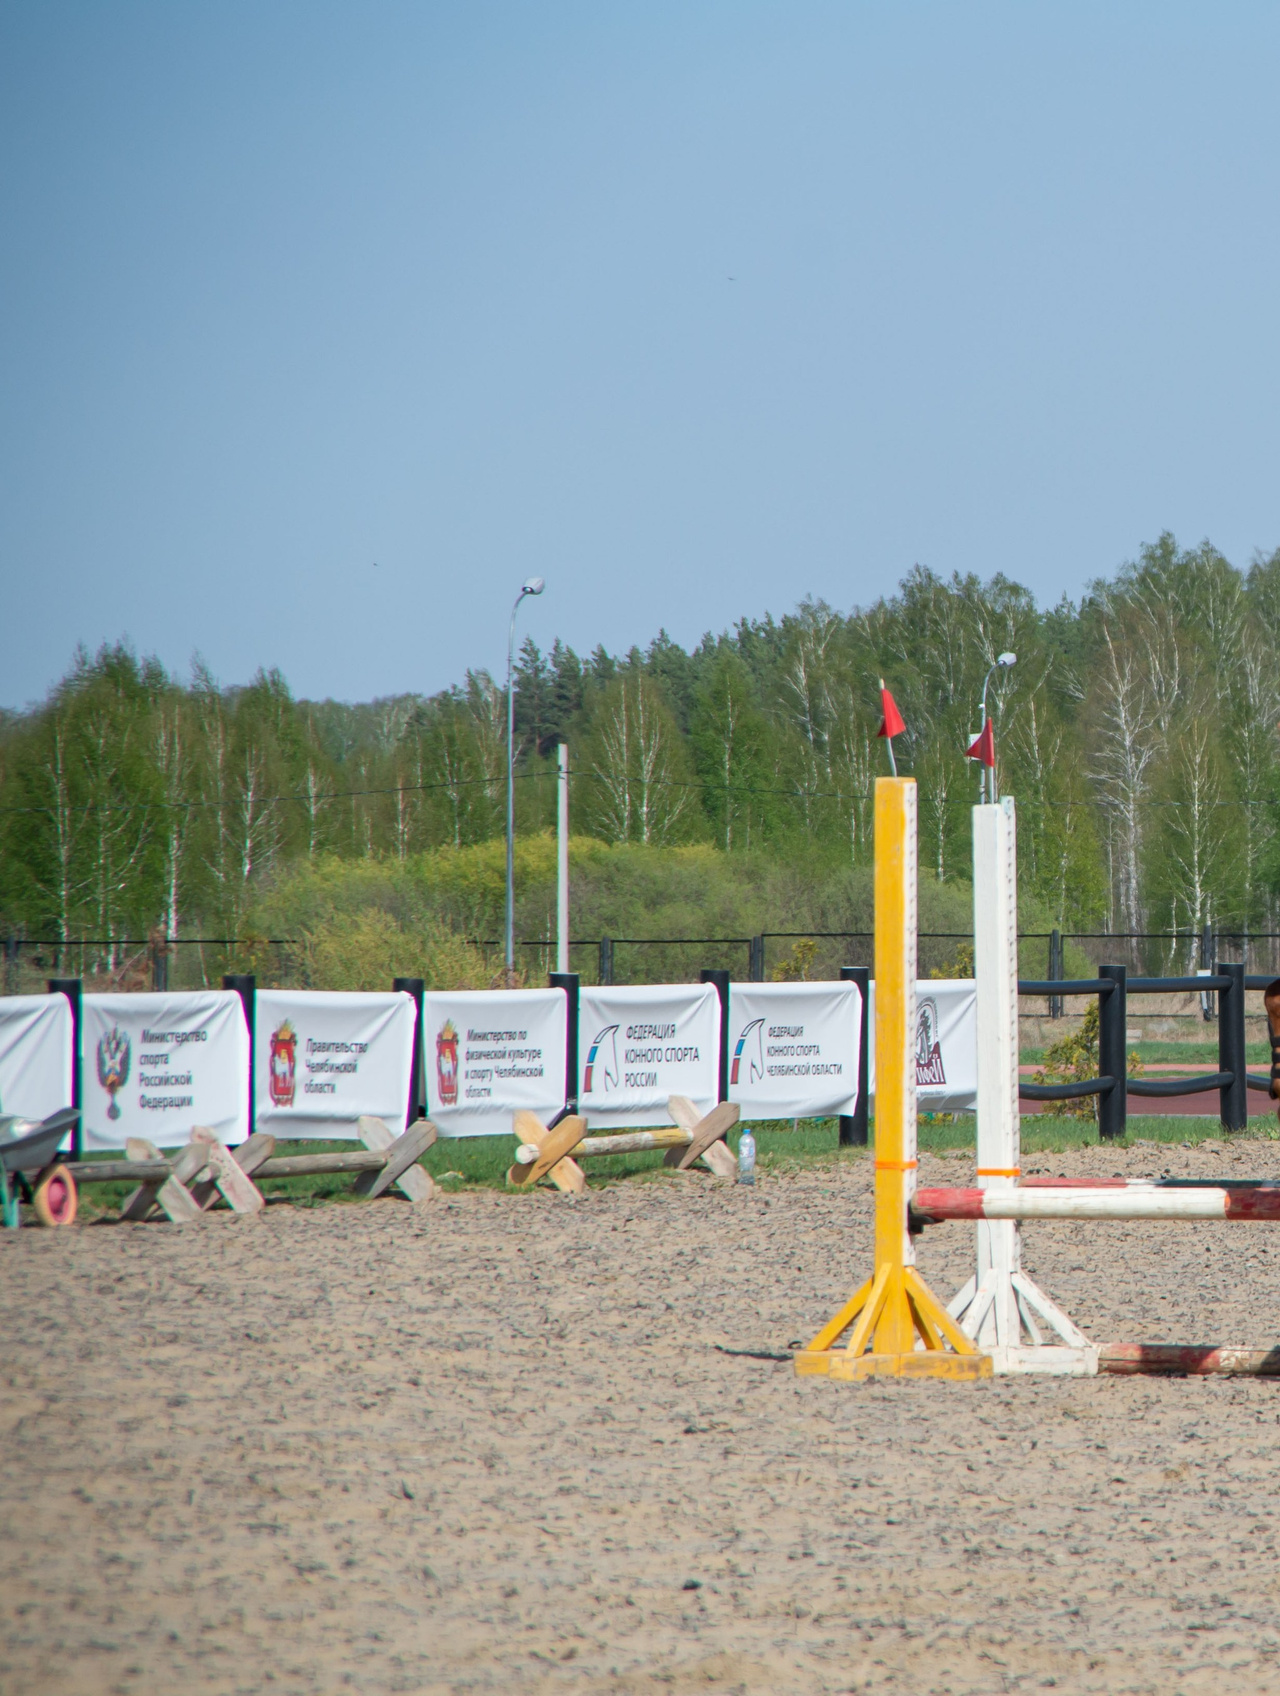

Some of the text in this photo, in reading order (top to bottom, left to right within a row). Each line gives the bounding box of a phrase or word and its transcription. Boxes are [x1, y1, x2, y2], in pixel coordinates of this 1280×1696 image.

[140, 1028, 207, 1046] Министерство
[467, 1028, 527, 1044] Министерство по
[626, 1024, 676, 1041] ФЕДЕРАЦИЯ
[768, 1026, 804, 1039] ФЕДЕРАЦИЯ
[306, 1038, 368, 1056] Правительство
[465, 1046, 541, 1064] физической культуре
[767, 1045, 820, 1057] КОННОГО СПОРТА
[139, 1053, 169, 1069] спорта
[624, 1047, 700, 1064] КОННОГО СПОРТА
[305, 1059, 358, 1073] Челябинской
[470, 1069, 493, 1082] спорту
[495, 1064, 543, 1078] Челябинской
[767, 1062, 843, 1076] ЧЕЛЯБИНСКОЙ ОБЛАСТИ
[139, 1070, 193, 1087] Российской
[305, 1079, 336, 1094] области
[625, 1072, 657, 1087] РОССИИ
[465, 1085, 491, 1098] области
[139, 1095, 193, 1112] Федерации
